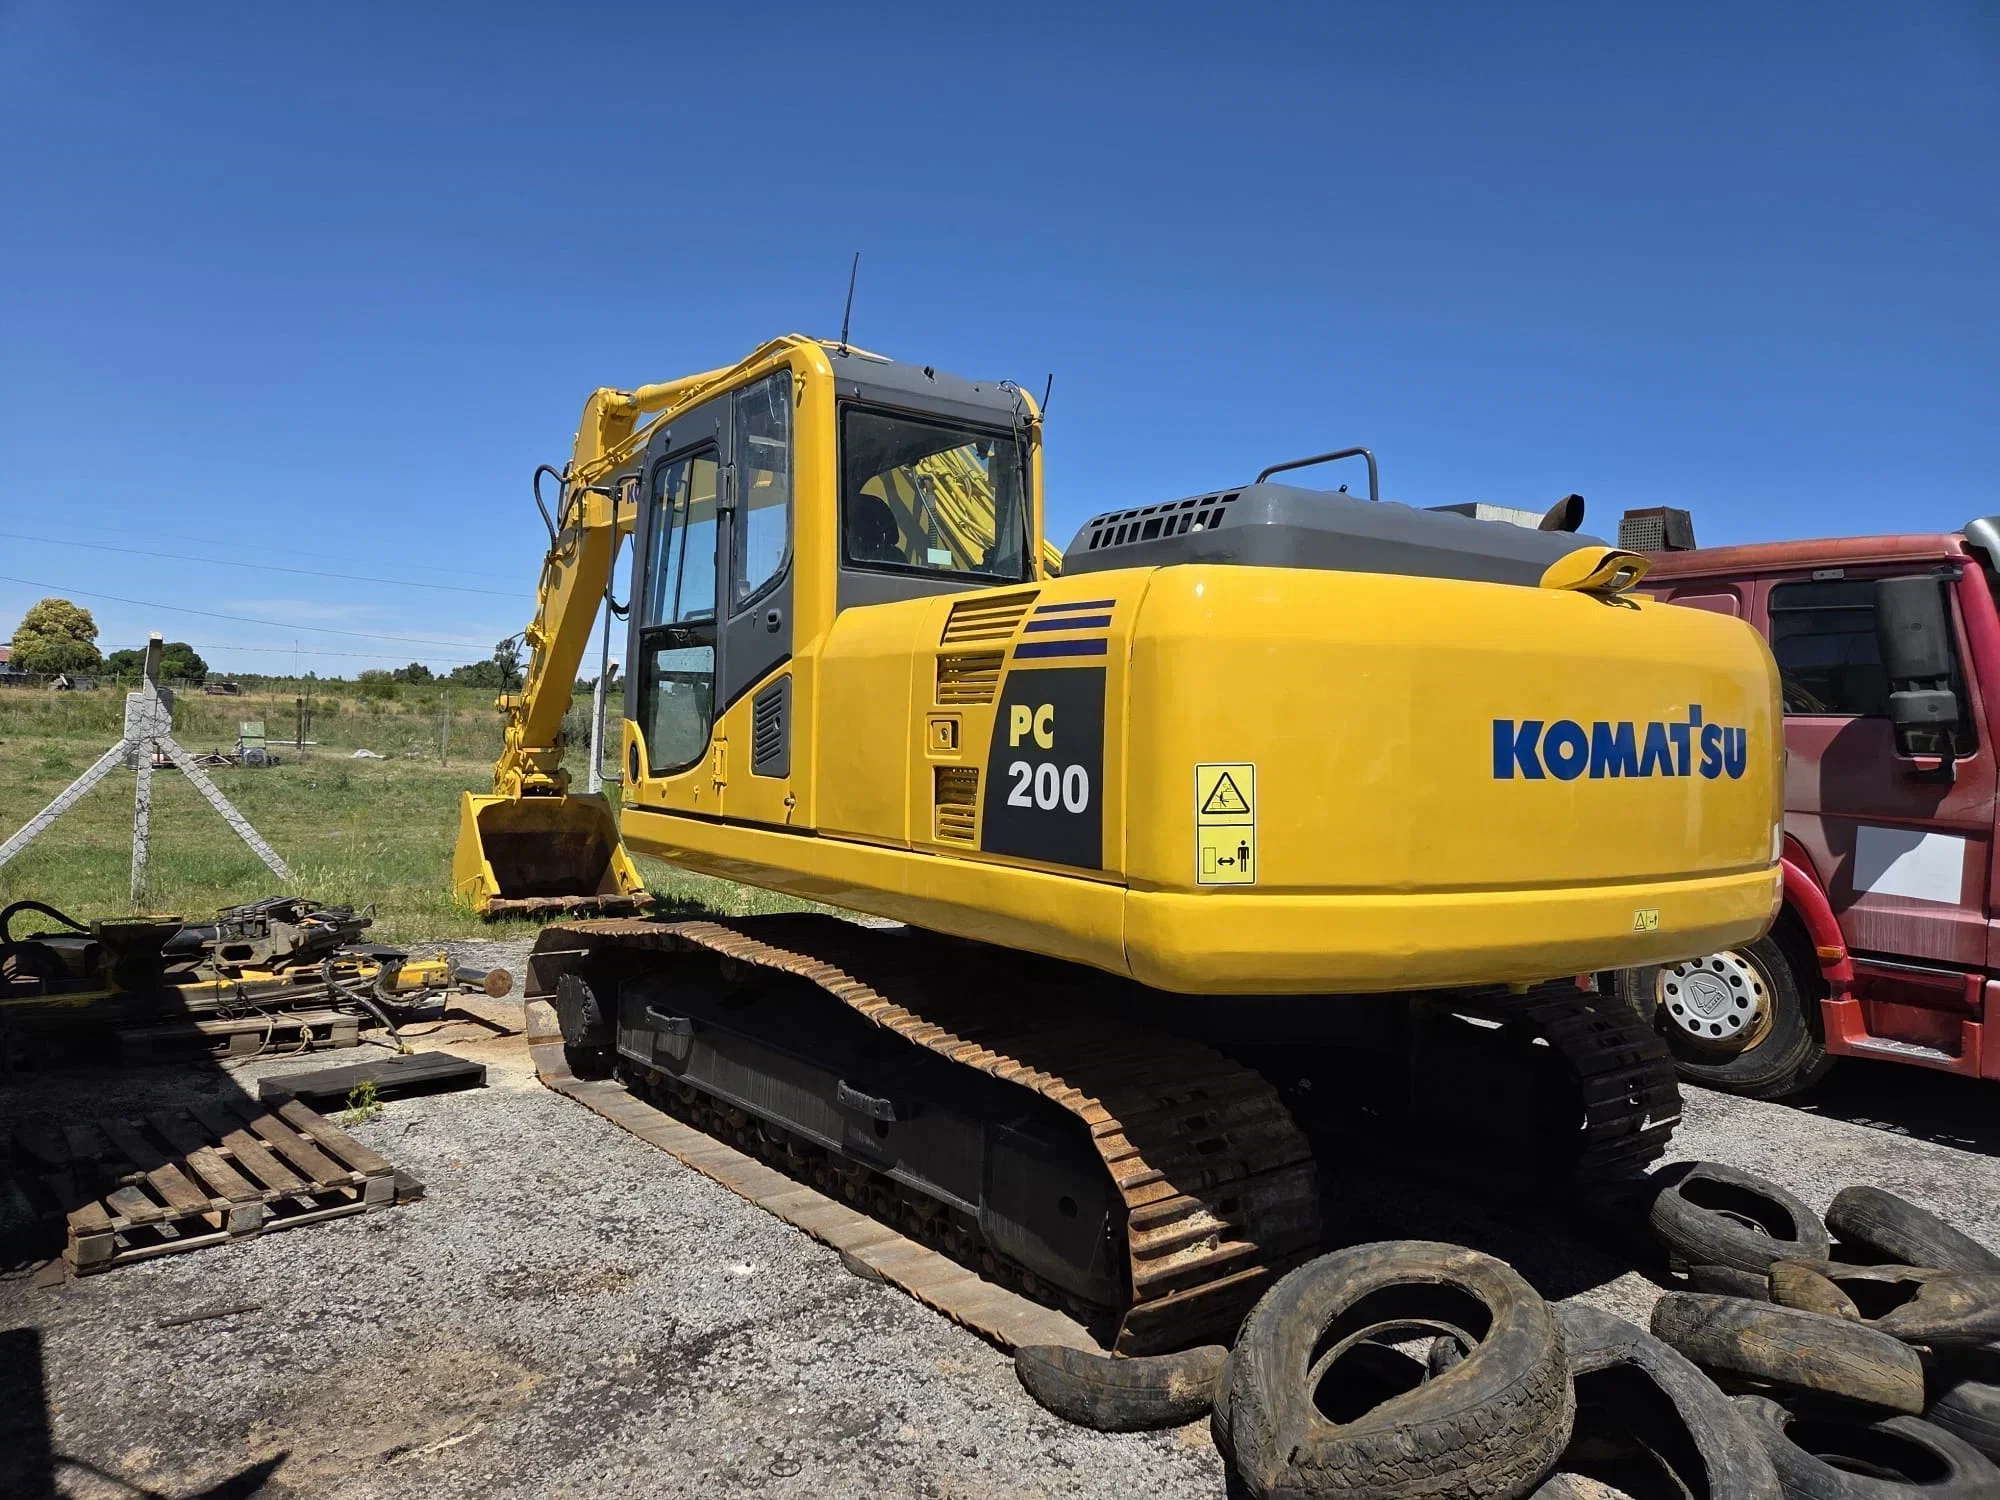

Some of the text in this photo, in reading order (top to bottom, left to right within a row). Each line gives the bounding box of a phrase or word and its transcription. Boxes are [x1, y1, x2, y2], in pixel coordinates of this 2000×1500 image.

[1009, 704, 1054, 749] PC
[1493, 704, 1746, 779] KOMATSU
[1007, 761, 1089, 813] 200
